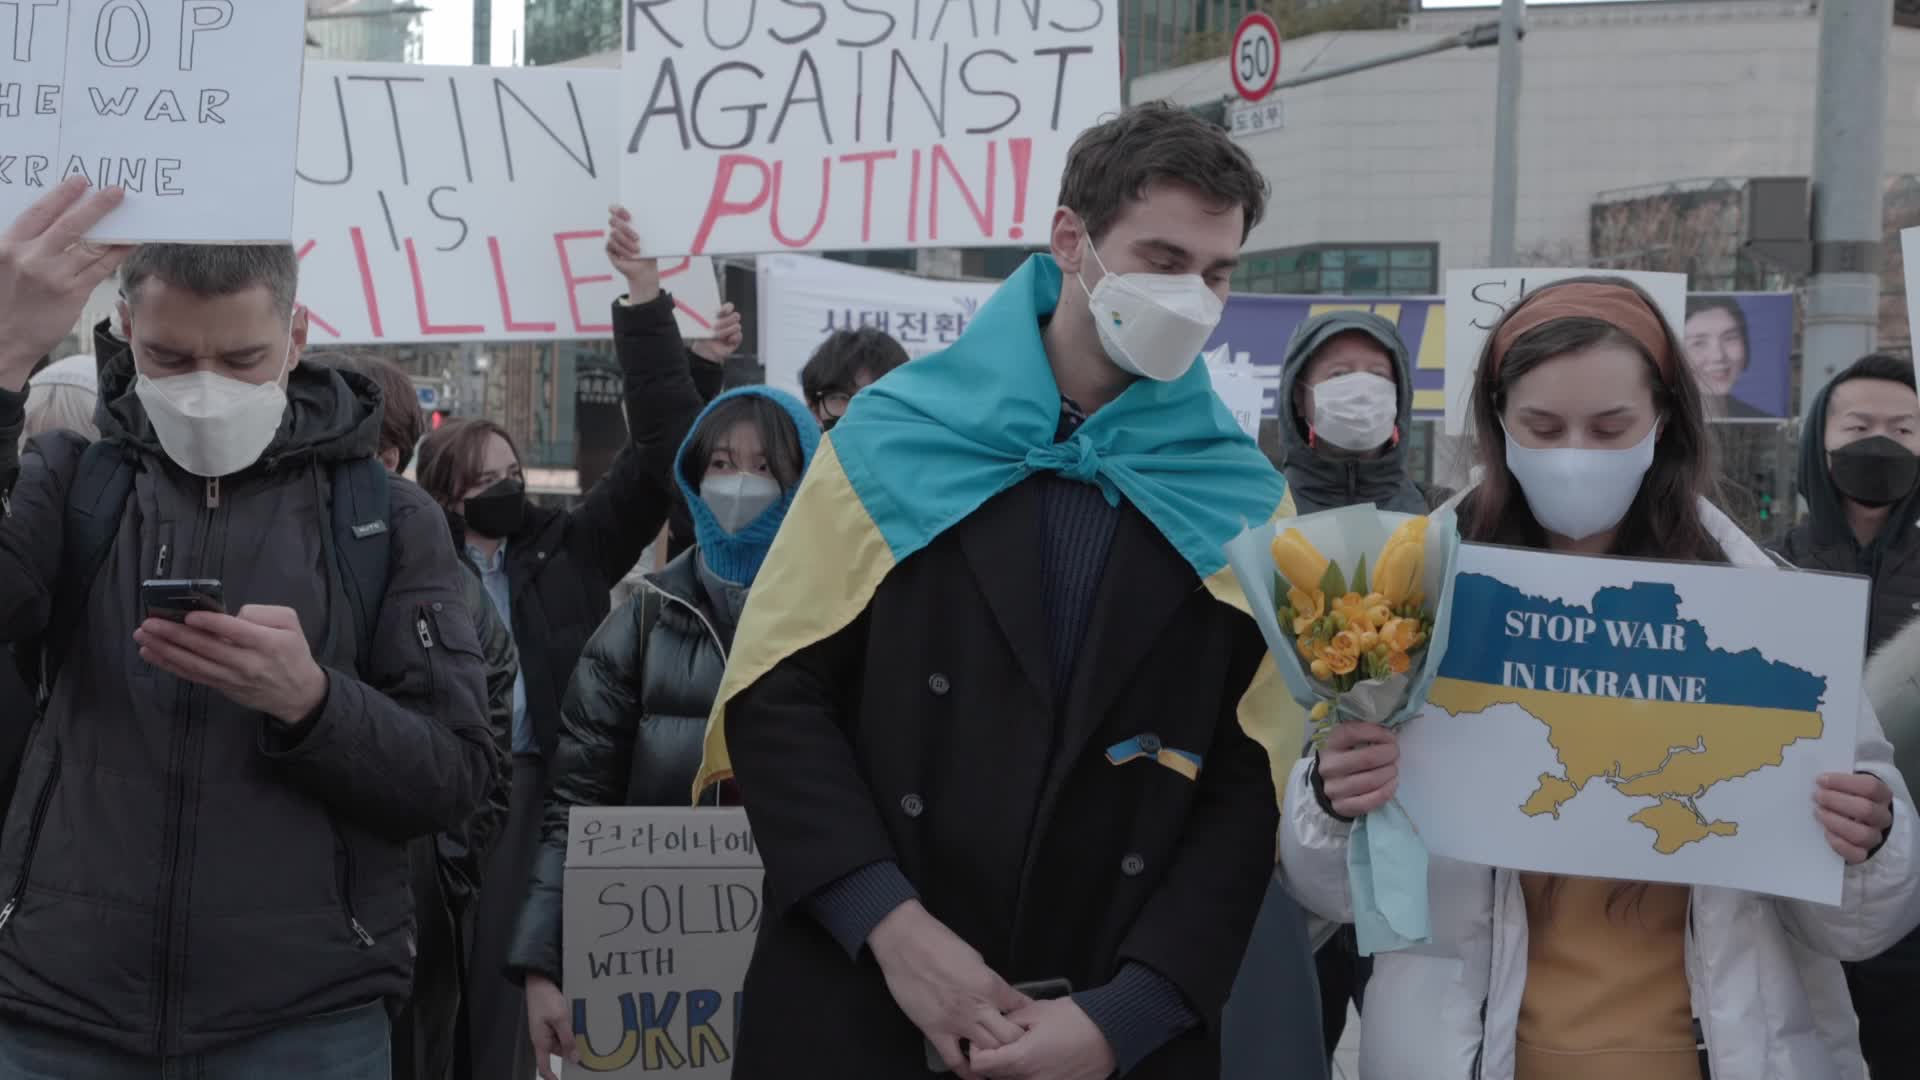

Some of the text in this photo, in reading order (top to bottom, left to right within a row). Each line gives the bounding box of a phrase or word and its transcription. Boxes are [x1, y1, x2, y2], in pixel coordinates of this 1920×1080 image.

[1241, 35, 1270, 82] 50
[87, 86, 230, 124] WAR
[627, 43, 1095, 153] AGAINST
[377, 186, 467, 251] IS
[689, 137, 1033, 256] PUTIN!
[1504, 609, 1686, 651] STOP WAR
[1502, 661, 1707, 703] IN UKRAINE
[597, 883, 761, 938] SOLID
[587, 948, 674, 978] WITH
[572, 989, 744, 1072] UKR
